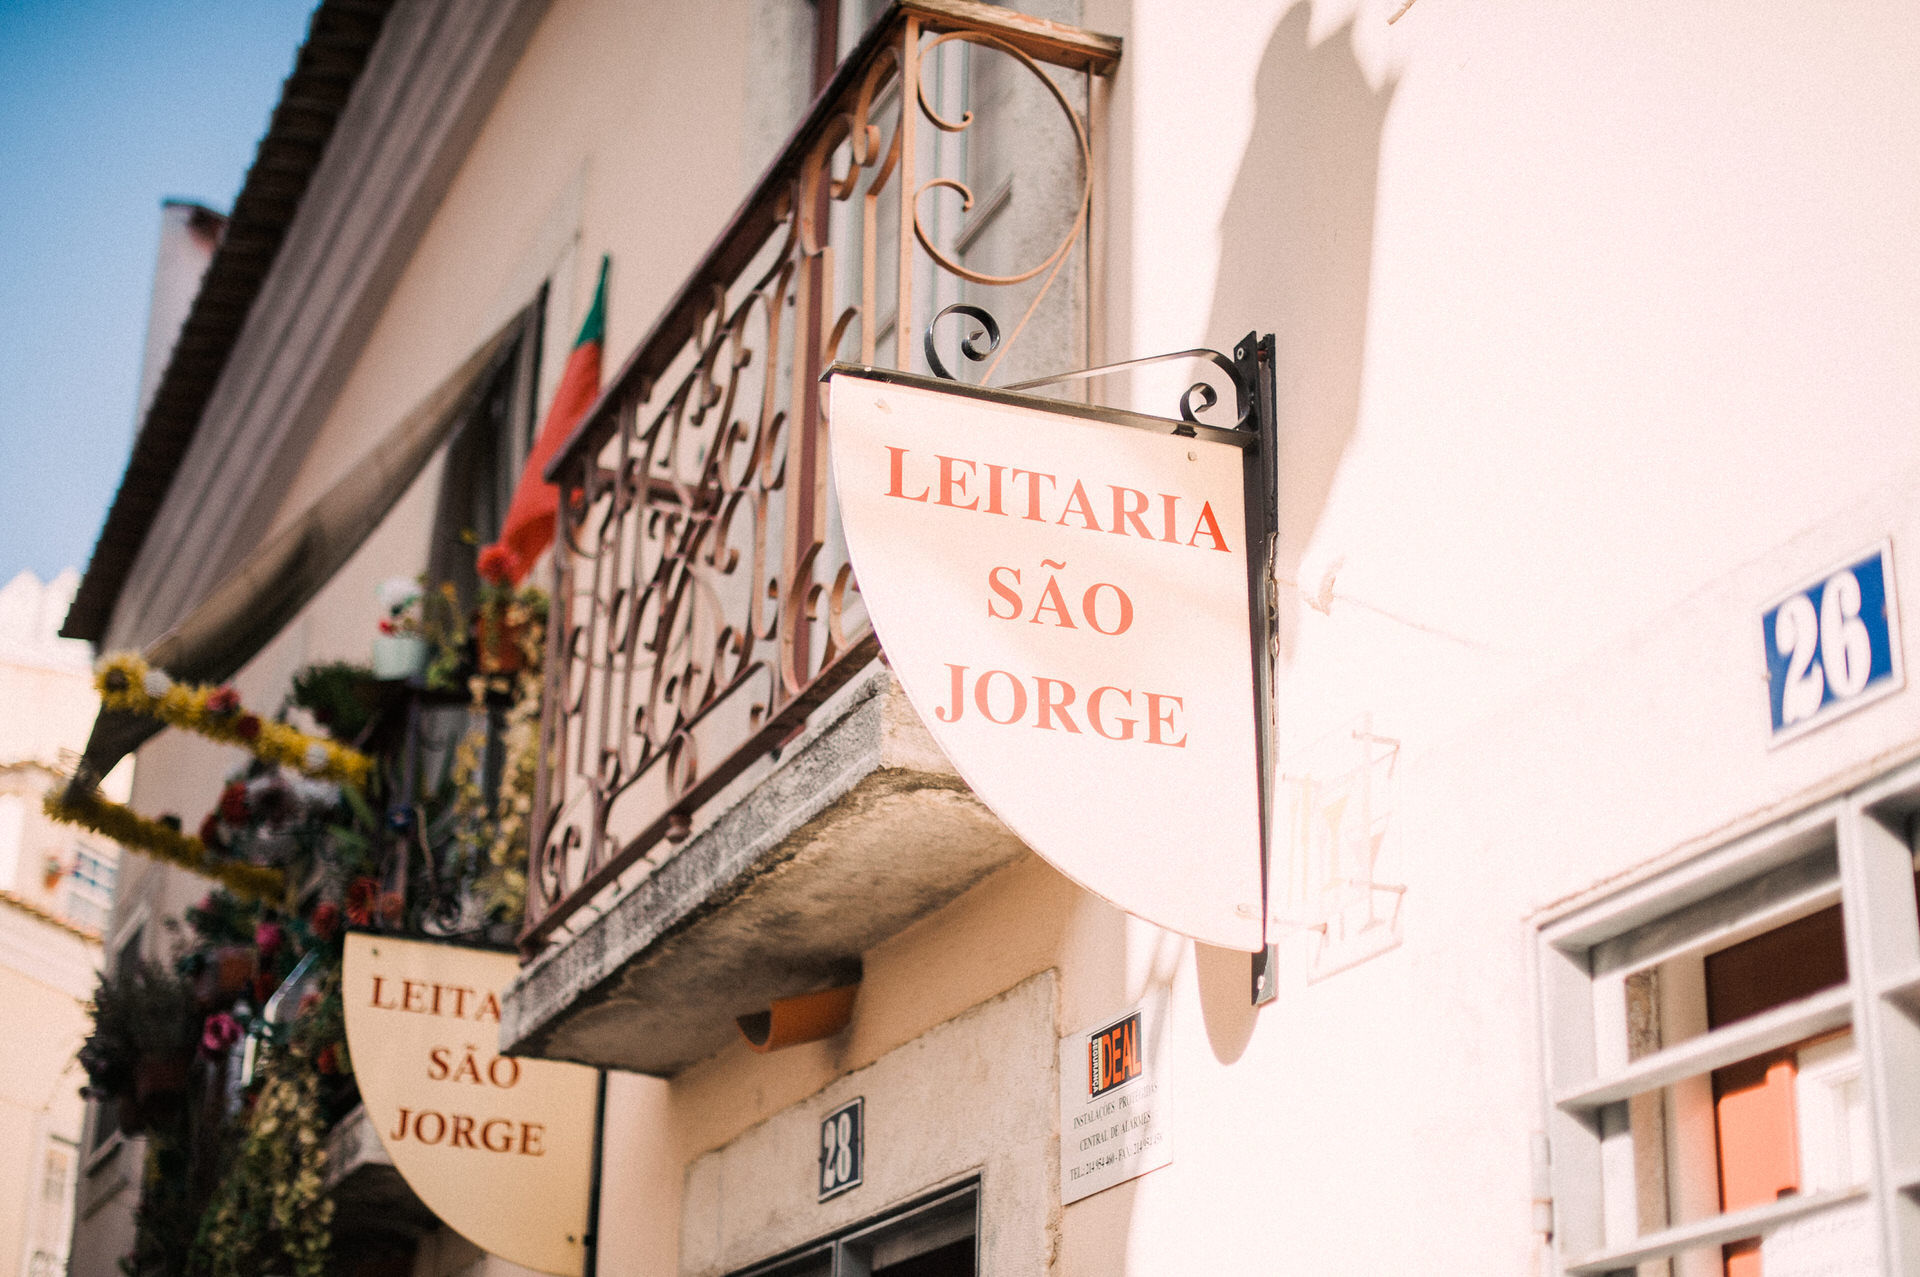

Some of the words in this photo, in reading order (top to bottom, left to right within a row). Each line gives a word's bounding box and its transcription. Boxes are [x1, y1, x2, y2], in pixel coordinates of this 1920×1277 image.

[883, 446, 1232, 553] LEITARIA
[986, 558, 1134, 636] SÃO
[1774, 569, 1872, 728] 26
[934, 663, 1188, 749] JORGE
[369, 975, 501, 1024] LEITA
[427, 1042, 522, 1089] SÃO
[390, 1104, 547, 1157] JORGE
[823, 1112, 852, 1189] 28
[1079, 1130, 1108, 1152] CENTRAL
[1110, 1124, 1119, 1139] DE
[1120, 1110, 1151, 1135] ALARMES
